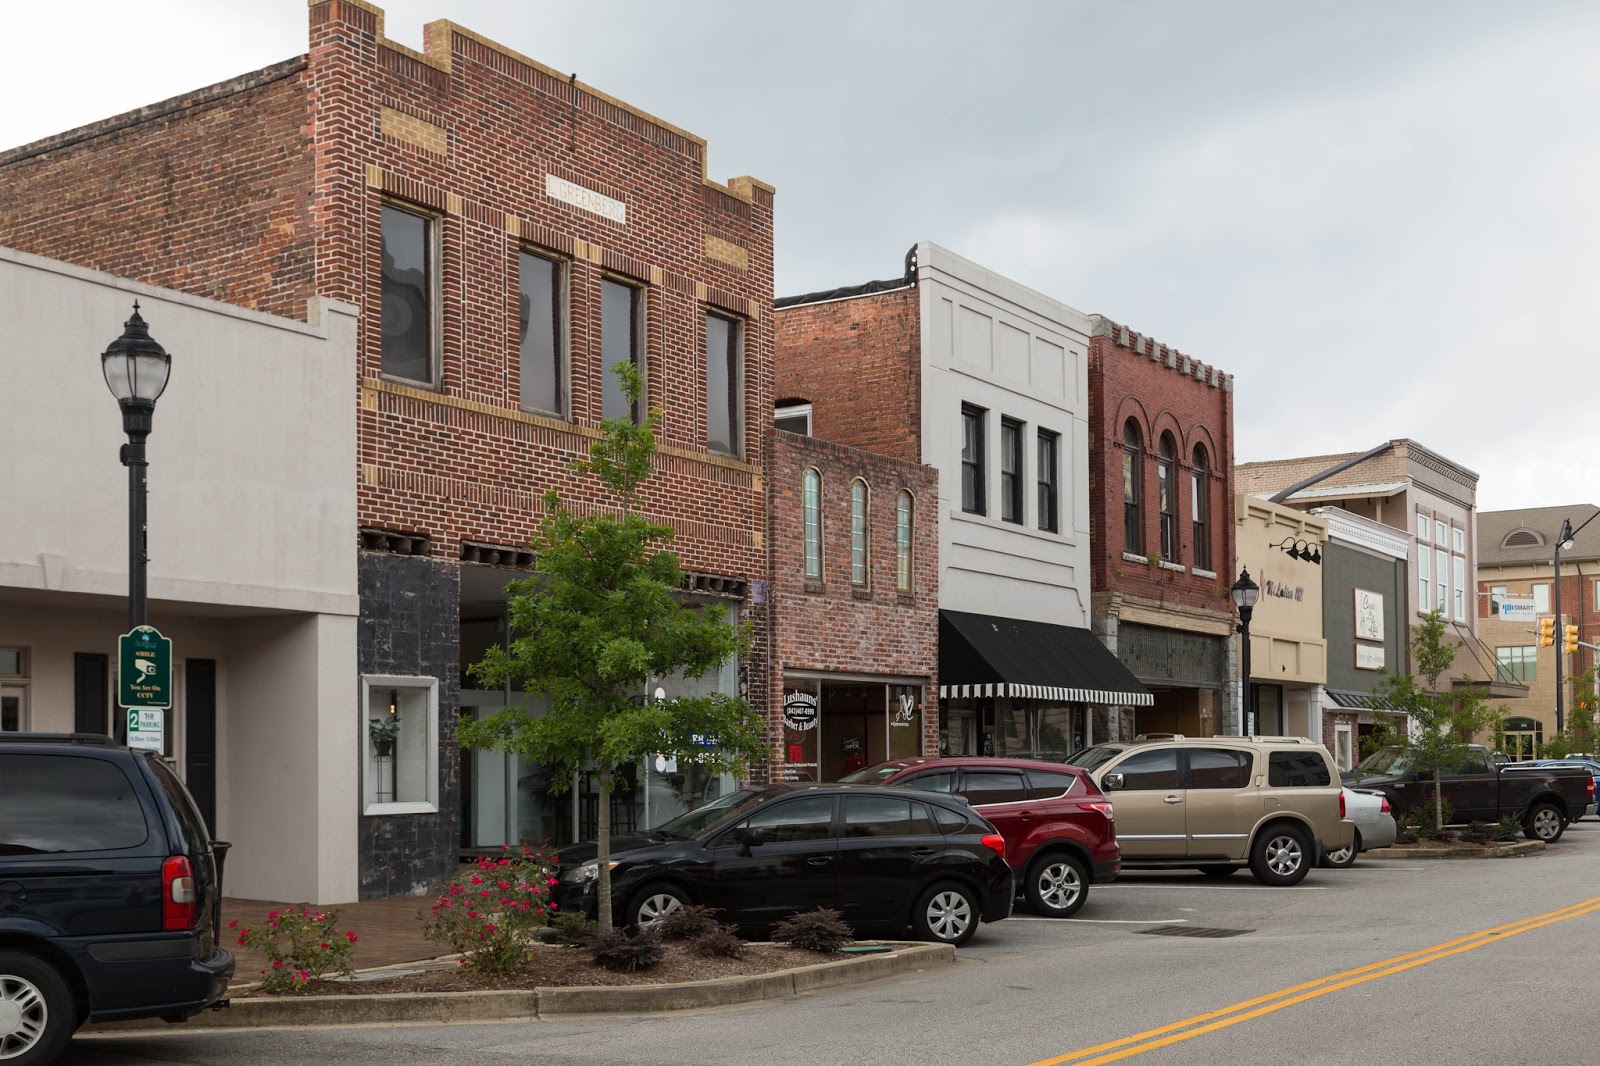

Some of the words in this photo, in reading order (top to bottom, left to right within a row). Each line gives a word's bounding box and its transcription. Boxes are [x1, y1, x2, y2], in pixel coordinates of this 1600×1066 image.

[560, 182, 624, 220] GREENBERG
[130, 713, 138, 728] 2
[140, 721, 160, 729] PARKING
[784, 713, 798, 731] Barber
[798, 721, 803, 731] &
